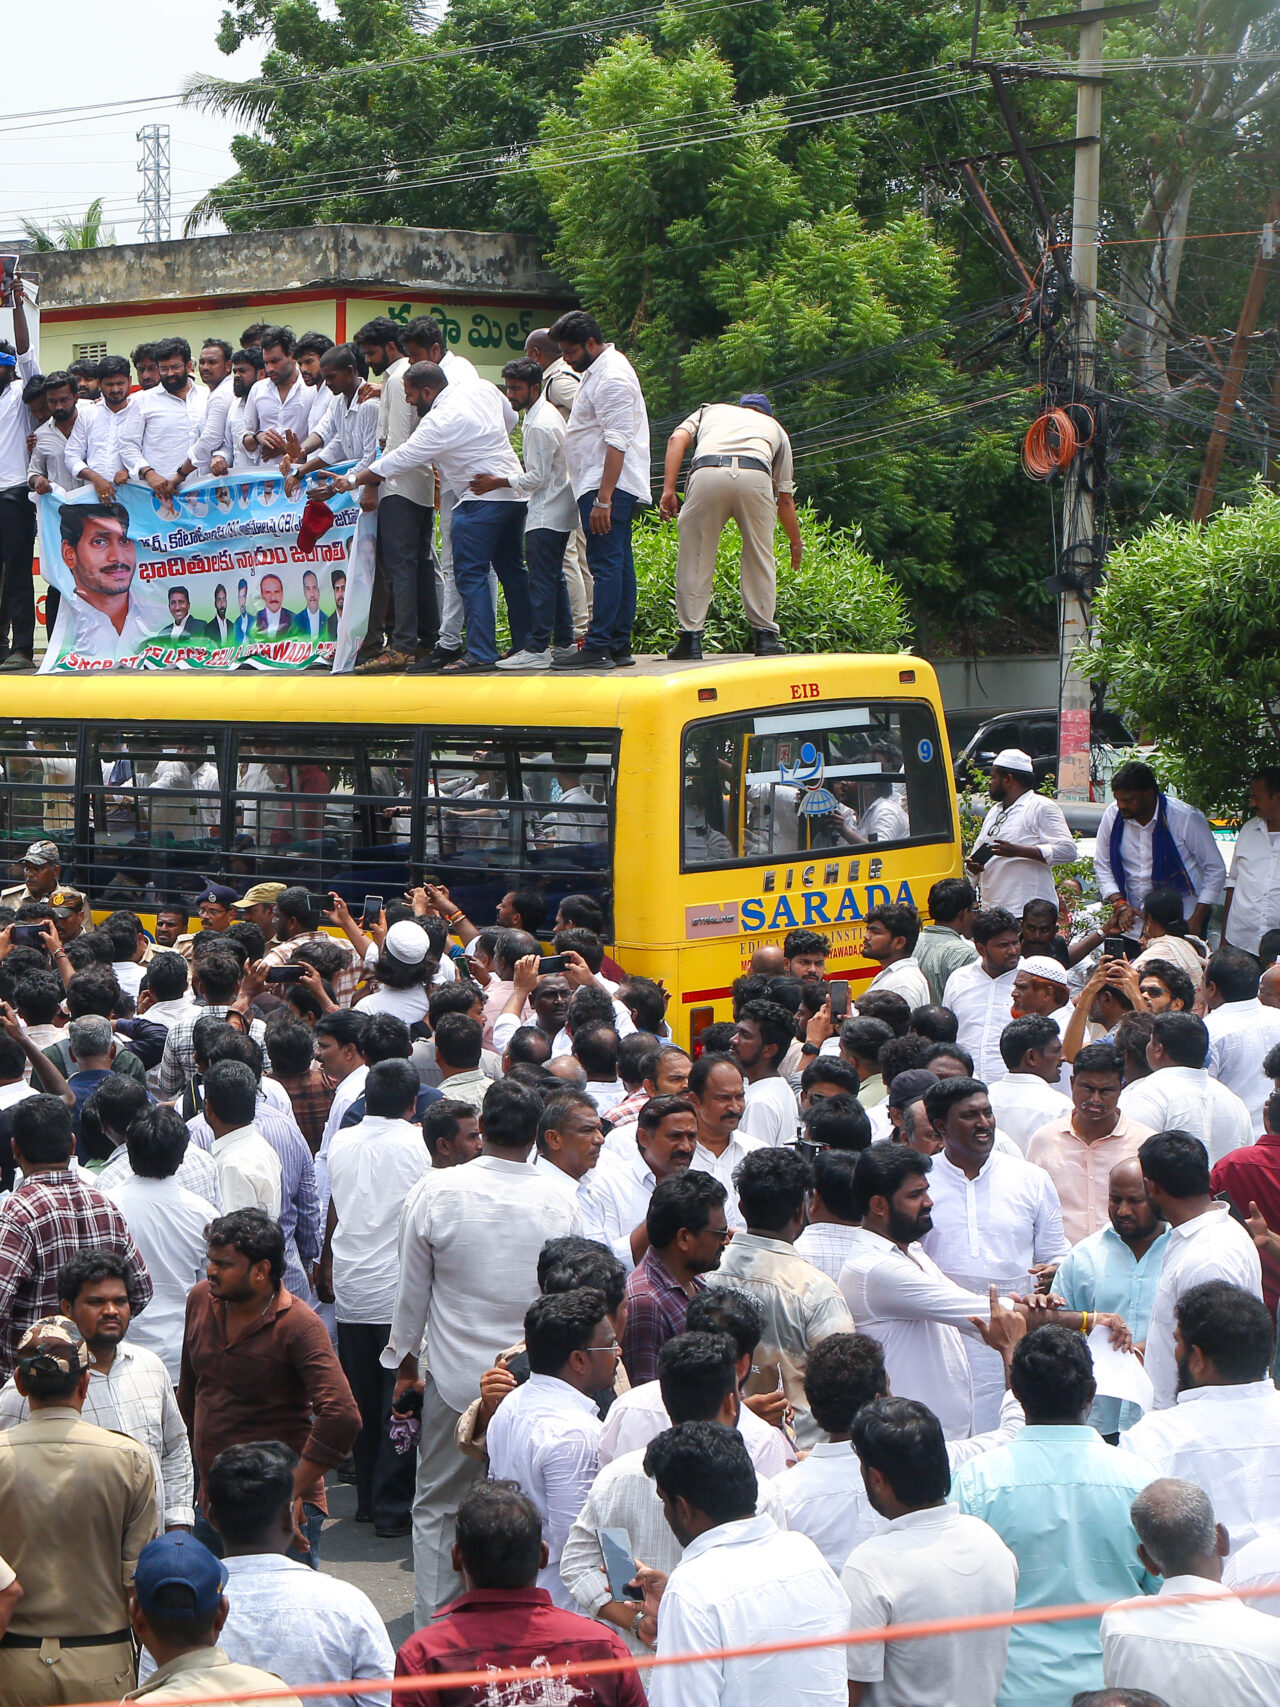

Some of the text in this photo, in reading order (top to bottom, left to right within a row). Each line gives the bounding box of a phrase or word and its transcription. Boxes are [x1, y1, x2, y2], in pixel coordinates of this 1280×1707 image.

[790, 683, 820, 699] EIB
[919, 740, 932, 762] 9
[763, 858, 883, 892] EICHER
[741, 880, 916, 932] SARADA
